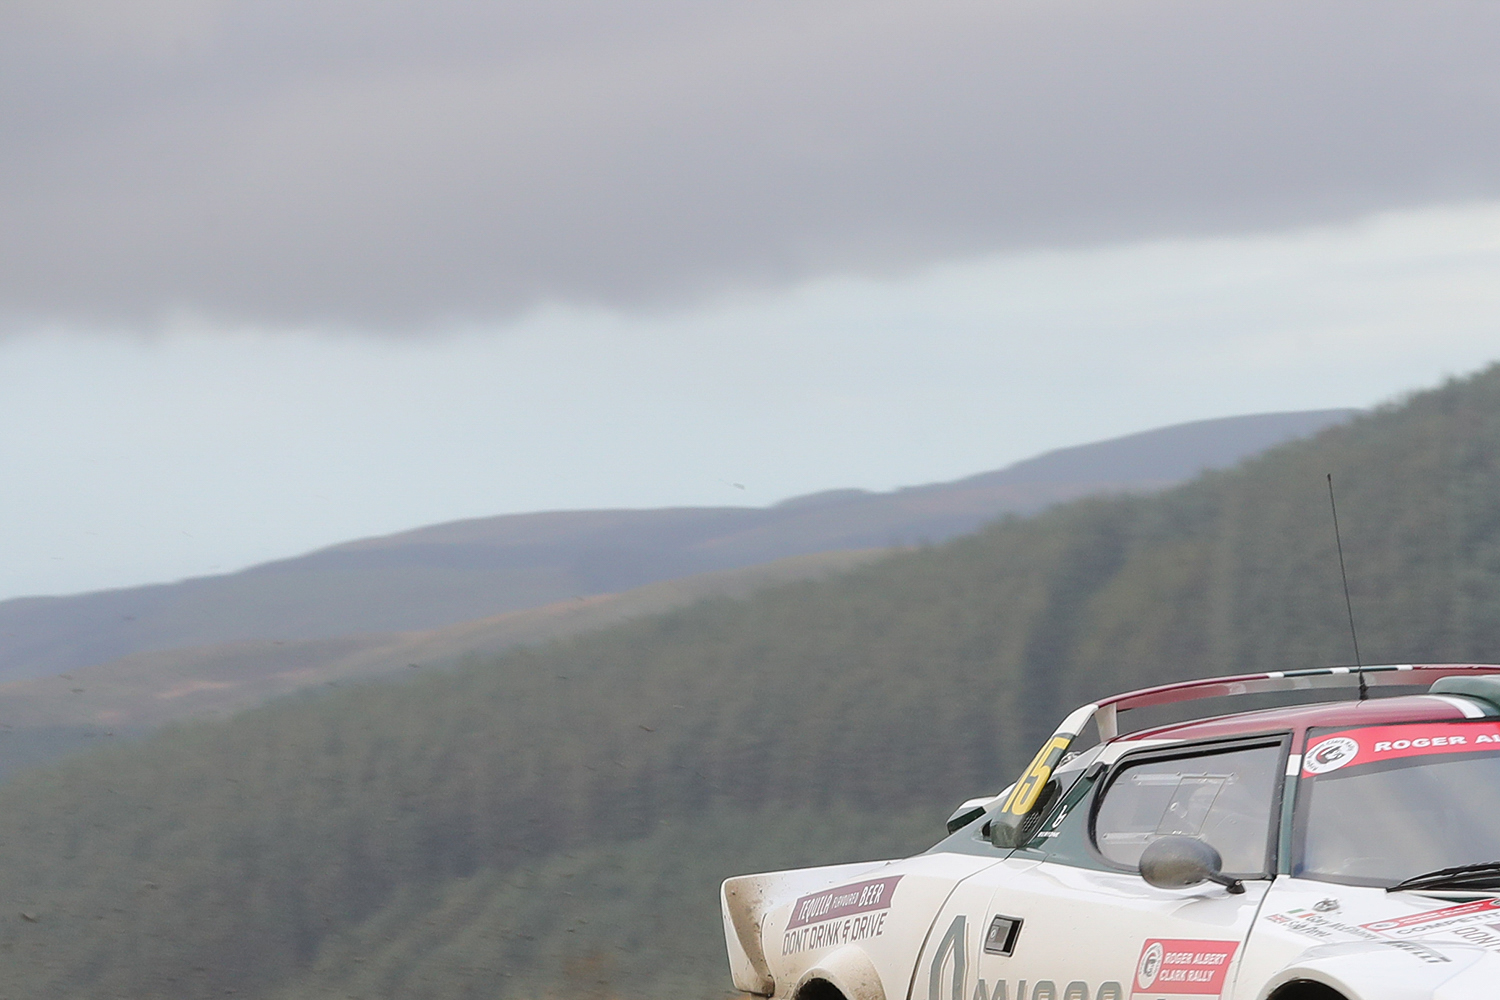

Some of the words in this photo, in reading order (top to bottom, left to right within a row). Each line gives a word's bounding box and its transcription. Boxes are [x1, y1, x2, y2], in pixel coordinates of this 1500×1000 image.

[1374, 736, 1467, 753] ROGER
[1001, 736, 1071, 815] 15
[798, 893, 834, 923] TEQUILA
[858, 883, 885, 907] BEER
[808, 921, 842, 950] DRINK
[842, 919, 851, 944] &
[851, 912, 888, 941] DRIVE
[1163, 952, 1194, 965] ROGER
[1192, 952, 1228, 965] ALBERT
[1159, 969, 1188, 982] CLARK
[1186, 970, 1216, 982] RALLY
